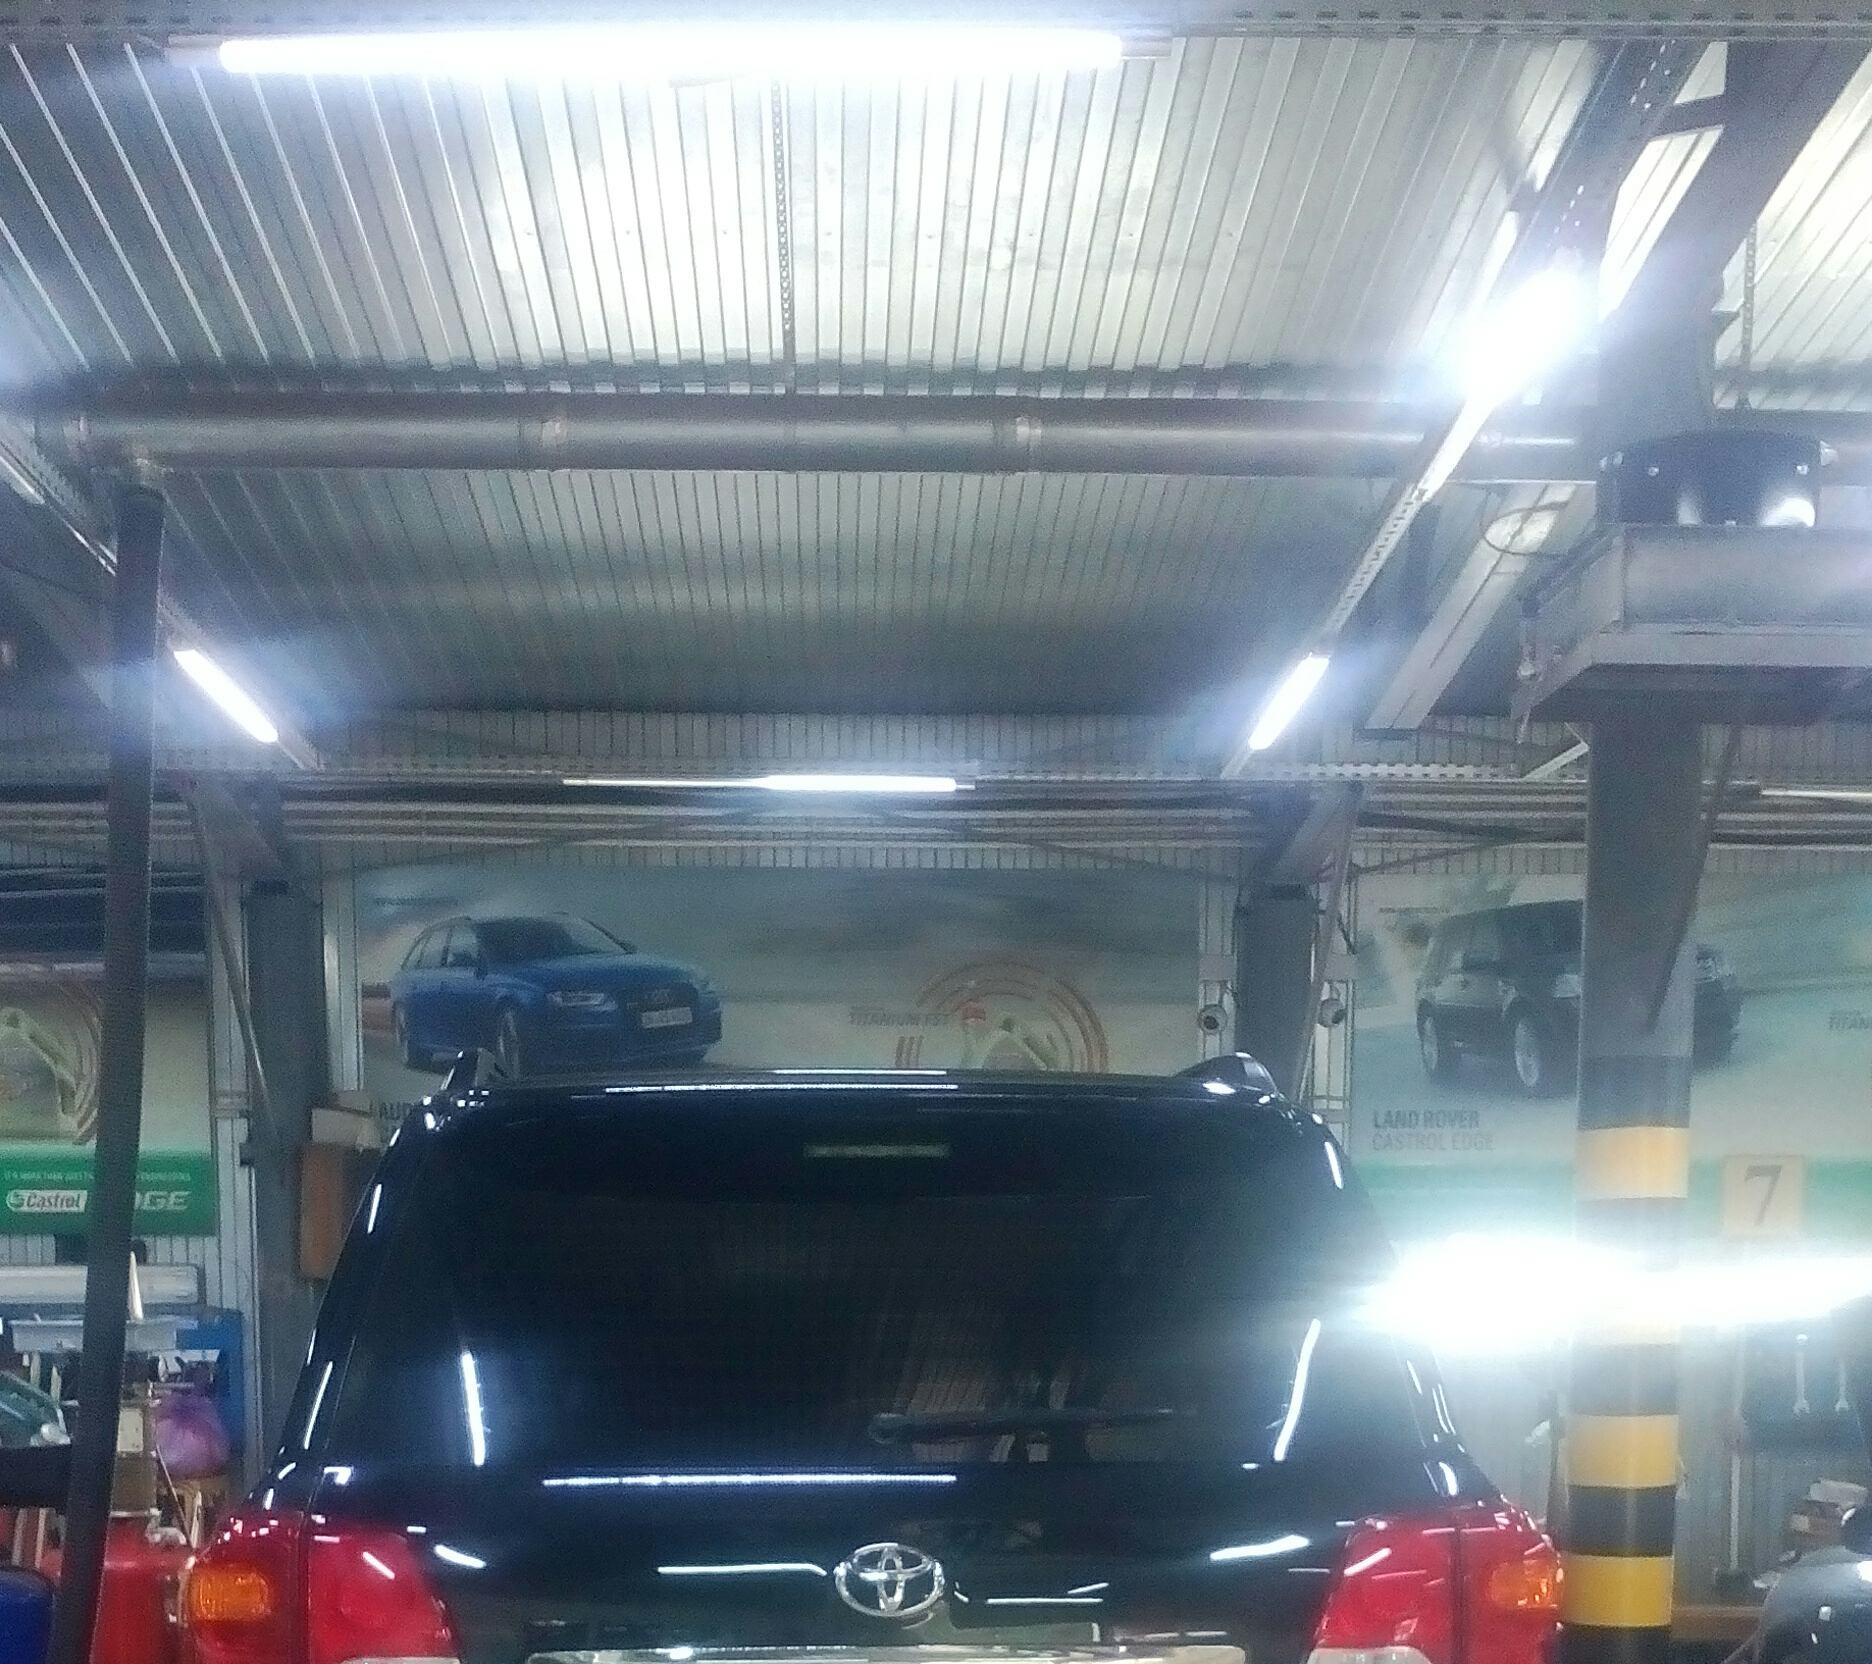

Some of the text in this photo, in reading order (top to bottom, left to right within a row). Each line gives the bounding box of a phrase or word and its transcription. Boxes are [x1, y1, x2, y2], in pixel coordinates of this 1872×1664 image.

[1373, 1109, 1480, 1129] LAND ROVER
[1372, 1132, 1496, 1151] CASTROL EDGE
[26, 1191, 81, 1210] Castrol
[1743, 1165, 1782, 1226] 7
